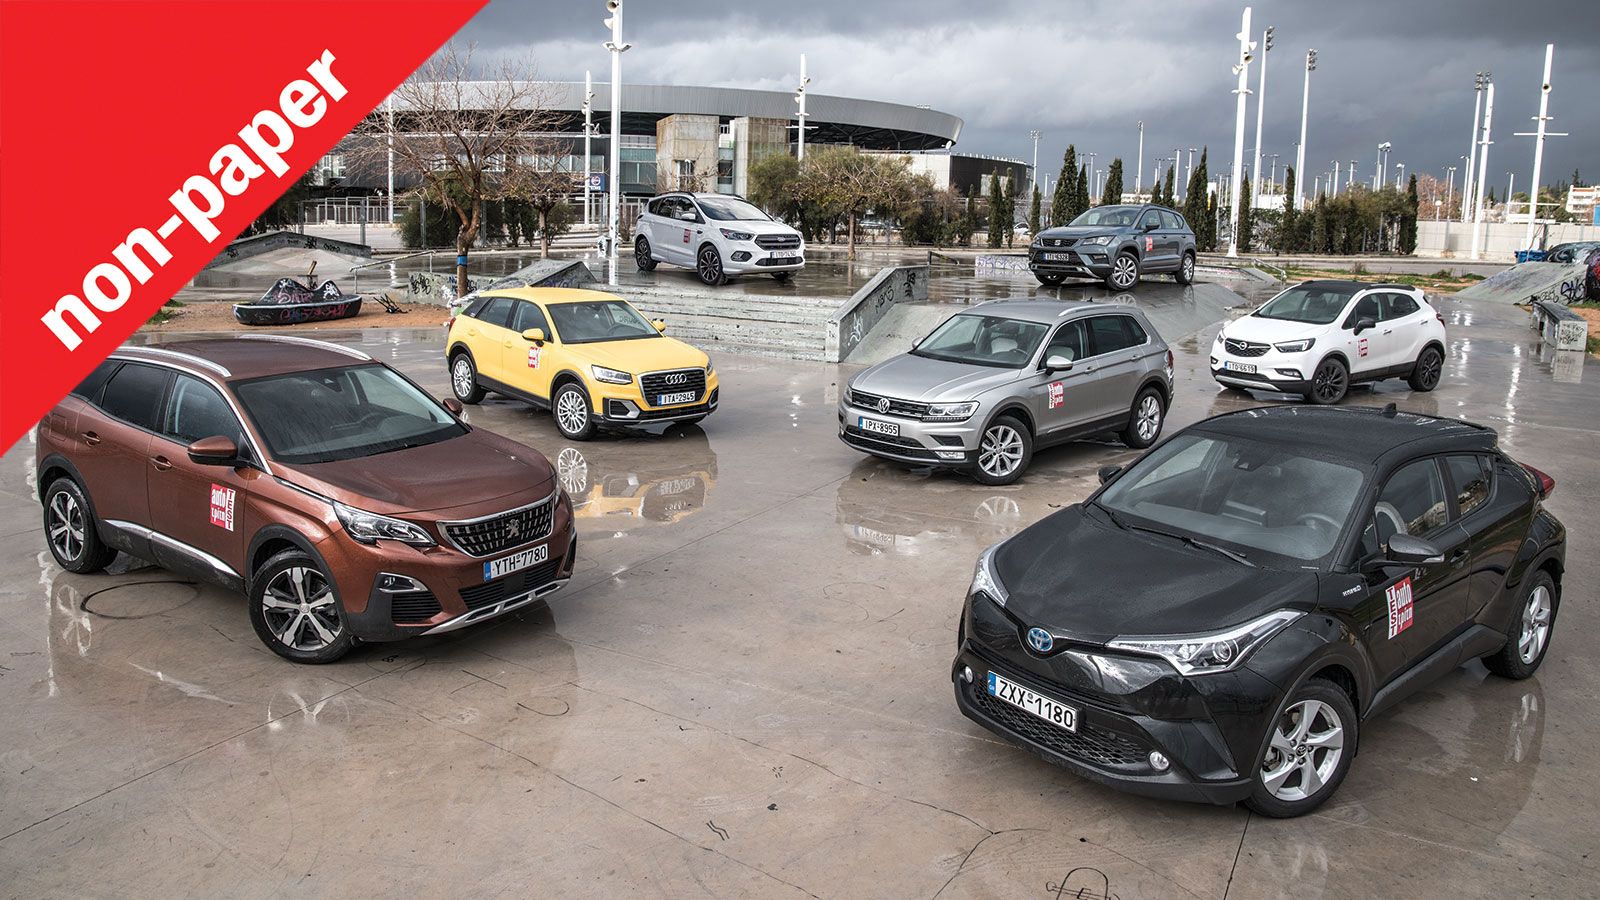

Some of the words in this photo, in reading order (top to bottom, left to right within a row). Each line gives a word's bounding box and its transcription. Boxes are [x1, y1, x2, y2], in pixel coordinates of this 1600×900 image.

[664, 392, 695, 404] ITA-2945
[865, 420, 898, 434] IPX-8955
[494, 546, 547, 575] YTH-7780
[1396, 581, 1413, 610] auto
[1386, 587, 1398, 637] TEST
[999, 679, 1074, 729] ZXX-1180
